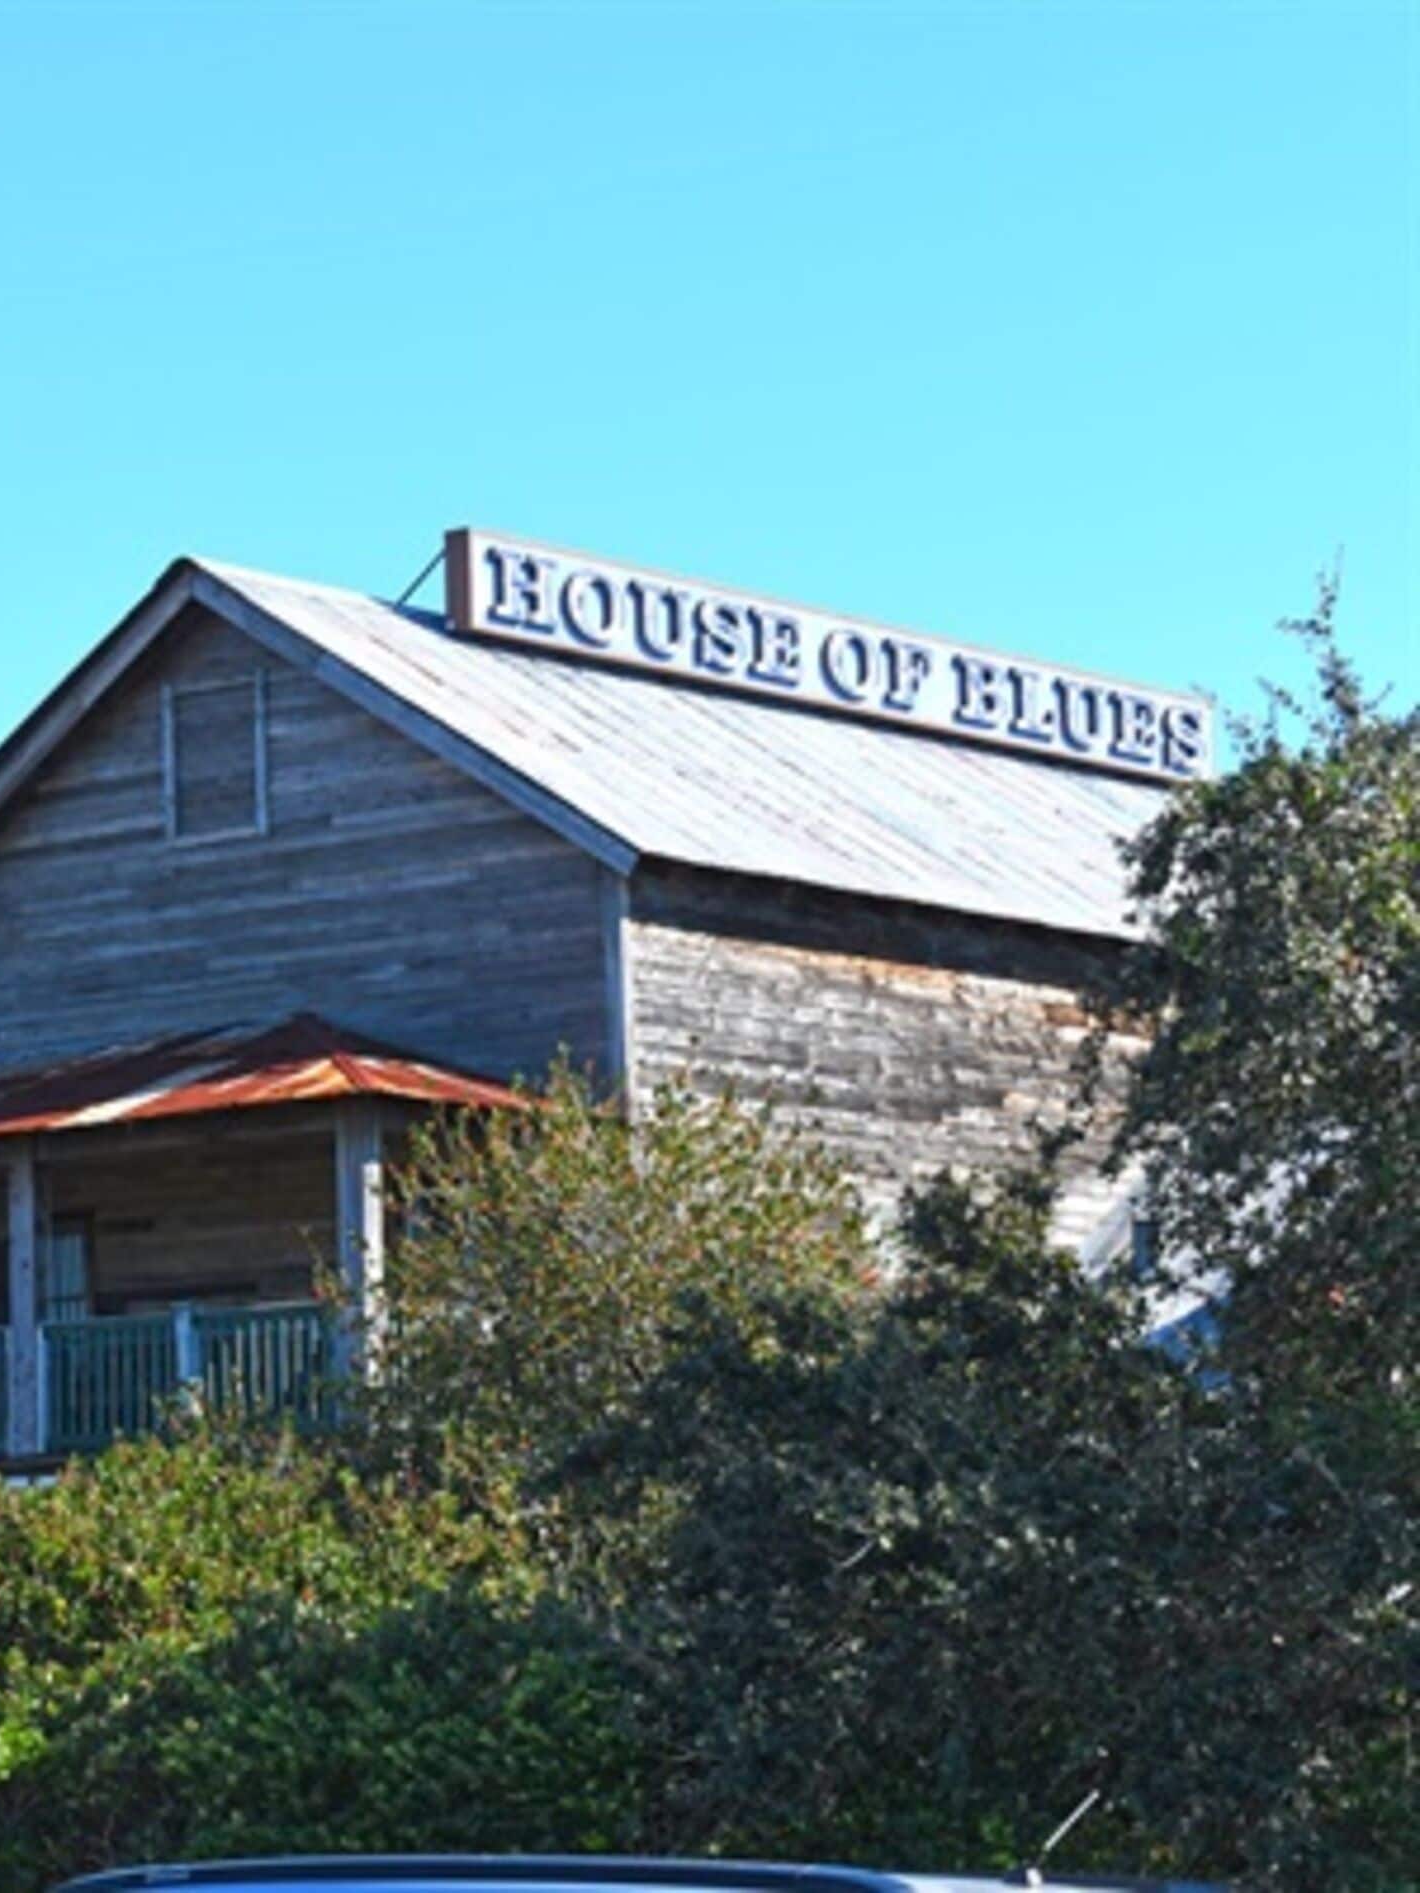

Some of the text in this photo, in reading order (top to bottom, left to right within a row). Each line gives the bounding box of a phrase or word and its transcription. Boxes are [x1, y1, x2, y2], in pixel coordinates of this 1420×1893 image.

[484, 545, 1205, 775] HOUSE OF BLUES
